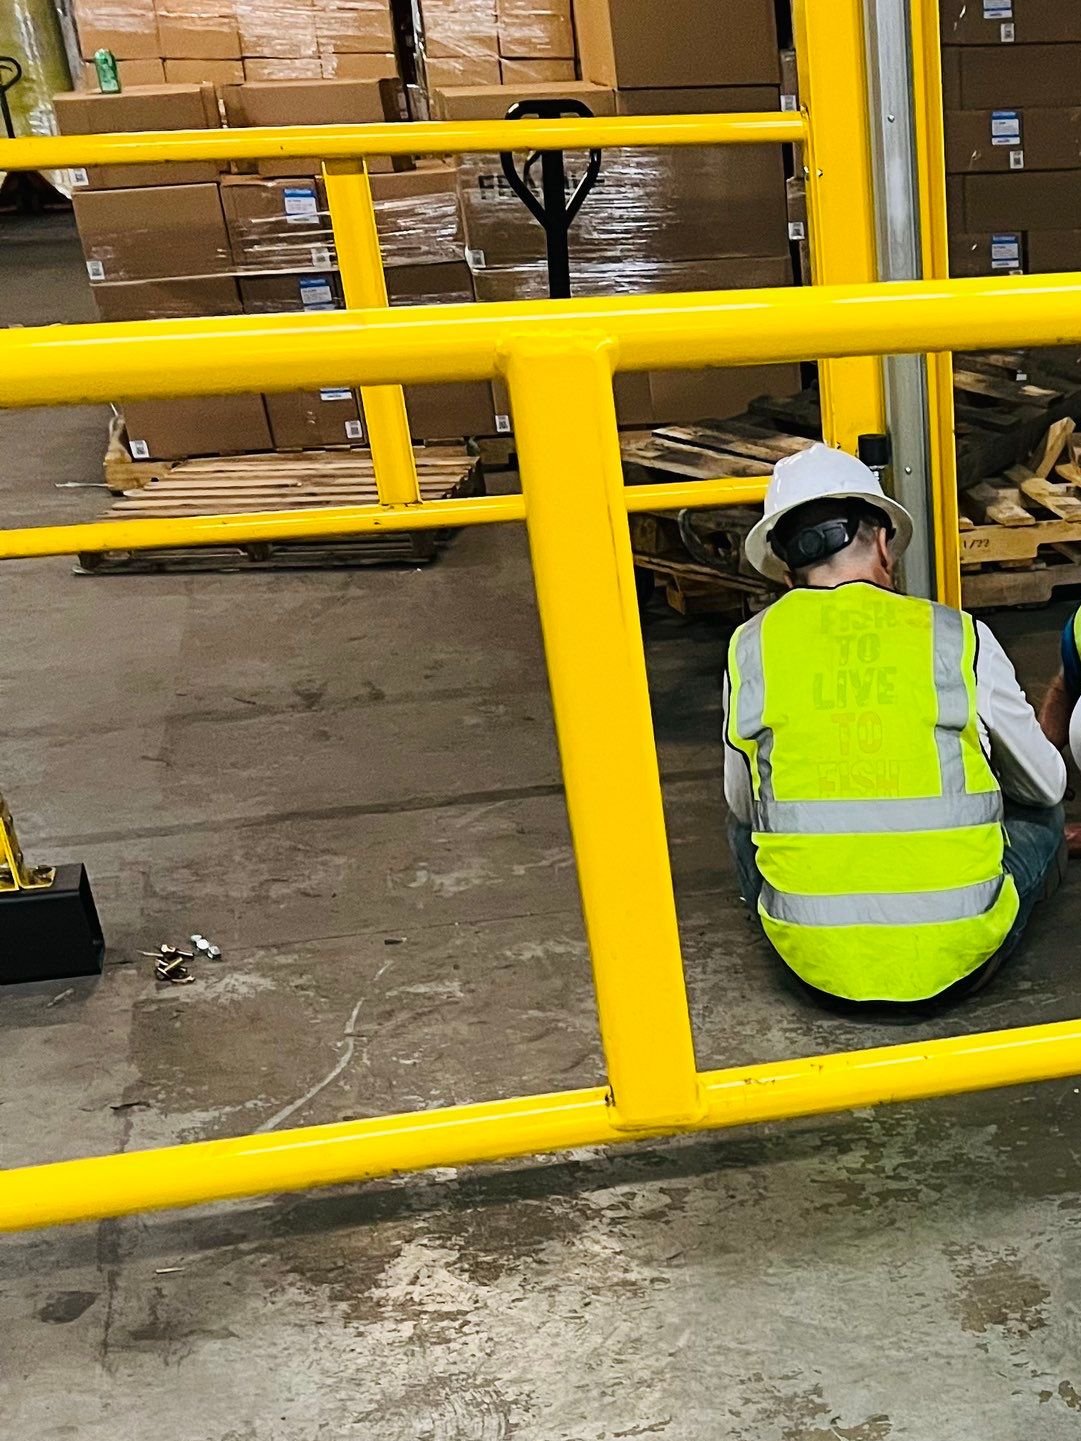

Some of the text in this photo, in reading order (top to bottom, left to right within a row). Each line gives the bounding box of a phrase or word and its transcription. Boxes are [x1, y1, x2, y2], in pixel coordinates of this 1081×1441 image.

[834, 632, 881, 666] TO
[812, 665, 898, 711] LIVE
[831, 710, 883, 756] TO
[816, 759, 900, 798] FISH
